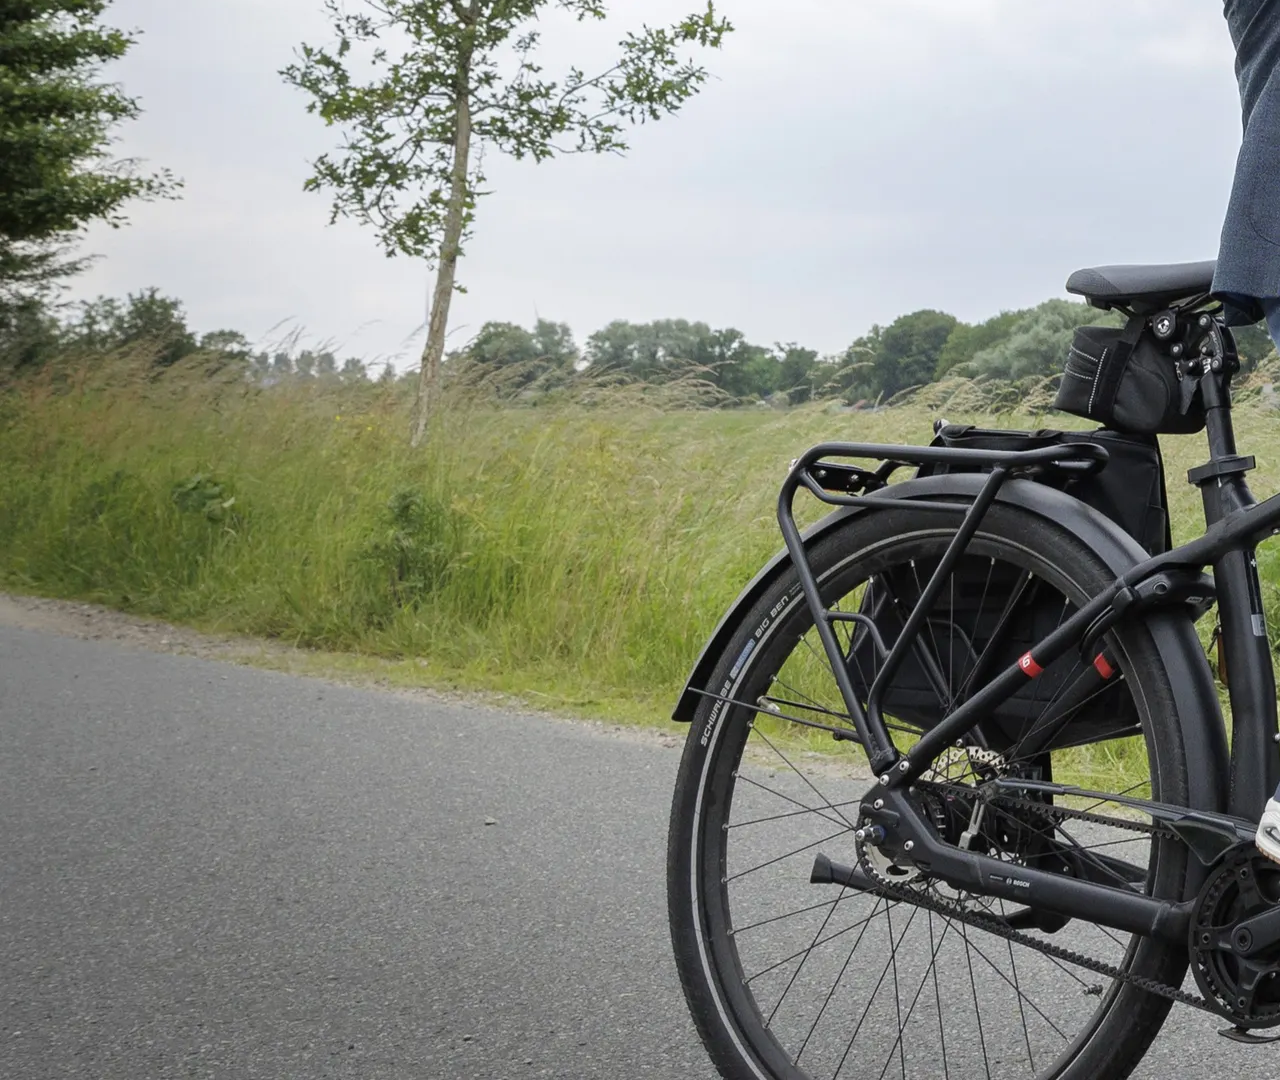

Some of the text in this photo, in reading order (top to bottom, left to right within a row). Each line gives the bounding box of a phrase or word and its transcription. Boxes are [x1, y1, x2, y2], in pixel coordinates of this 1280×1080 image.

[754, 595, 789, 638] BIG BEN
[700, 680, 732, 747] SCHWALBE
